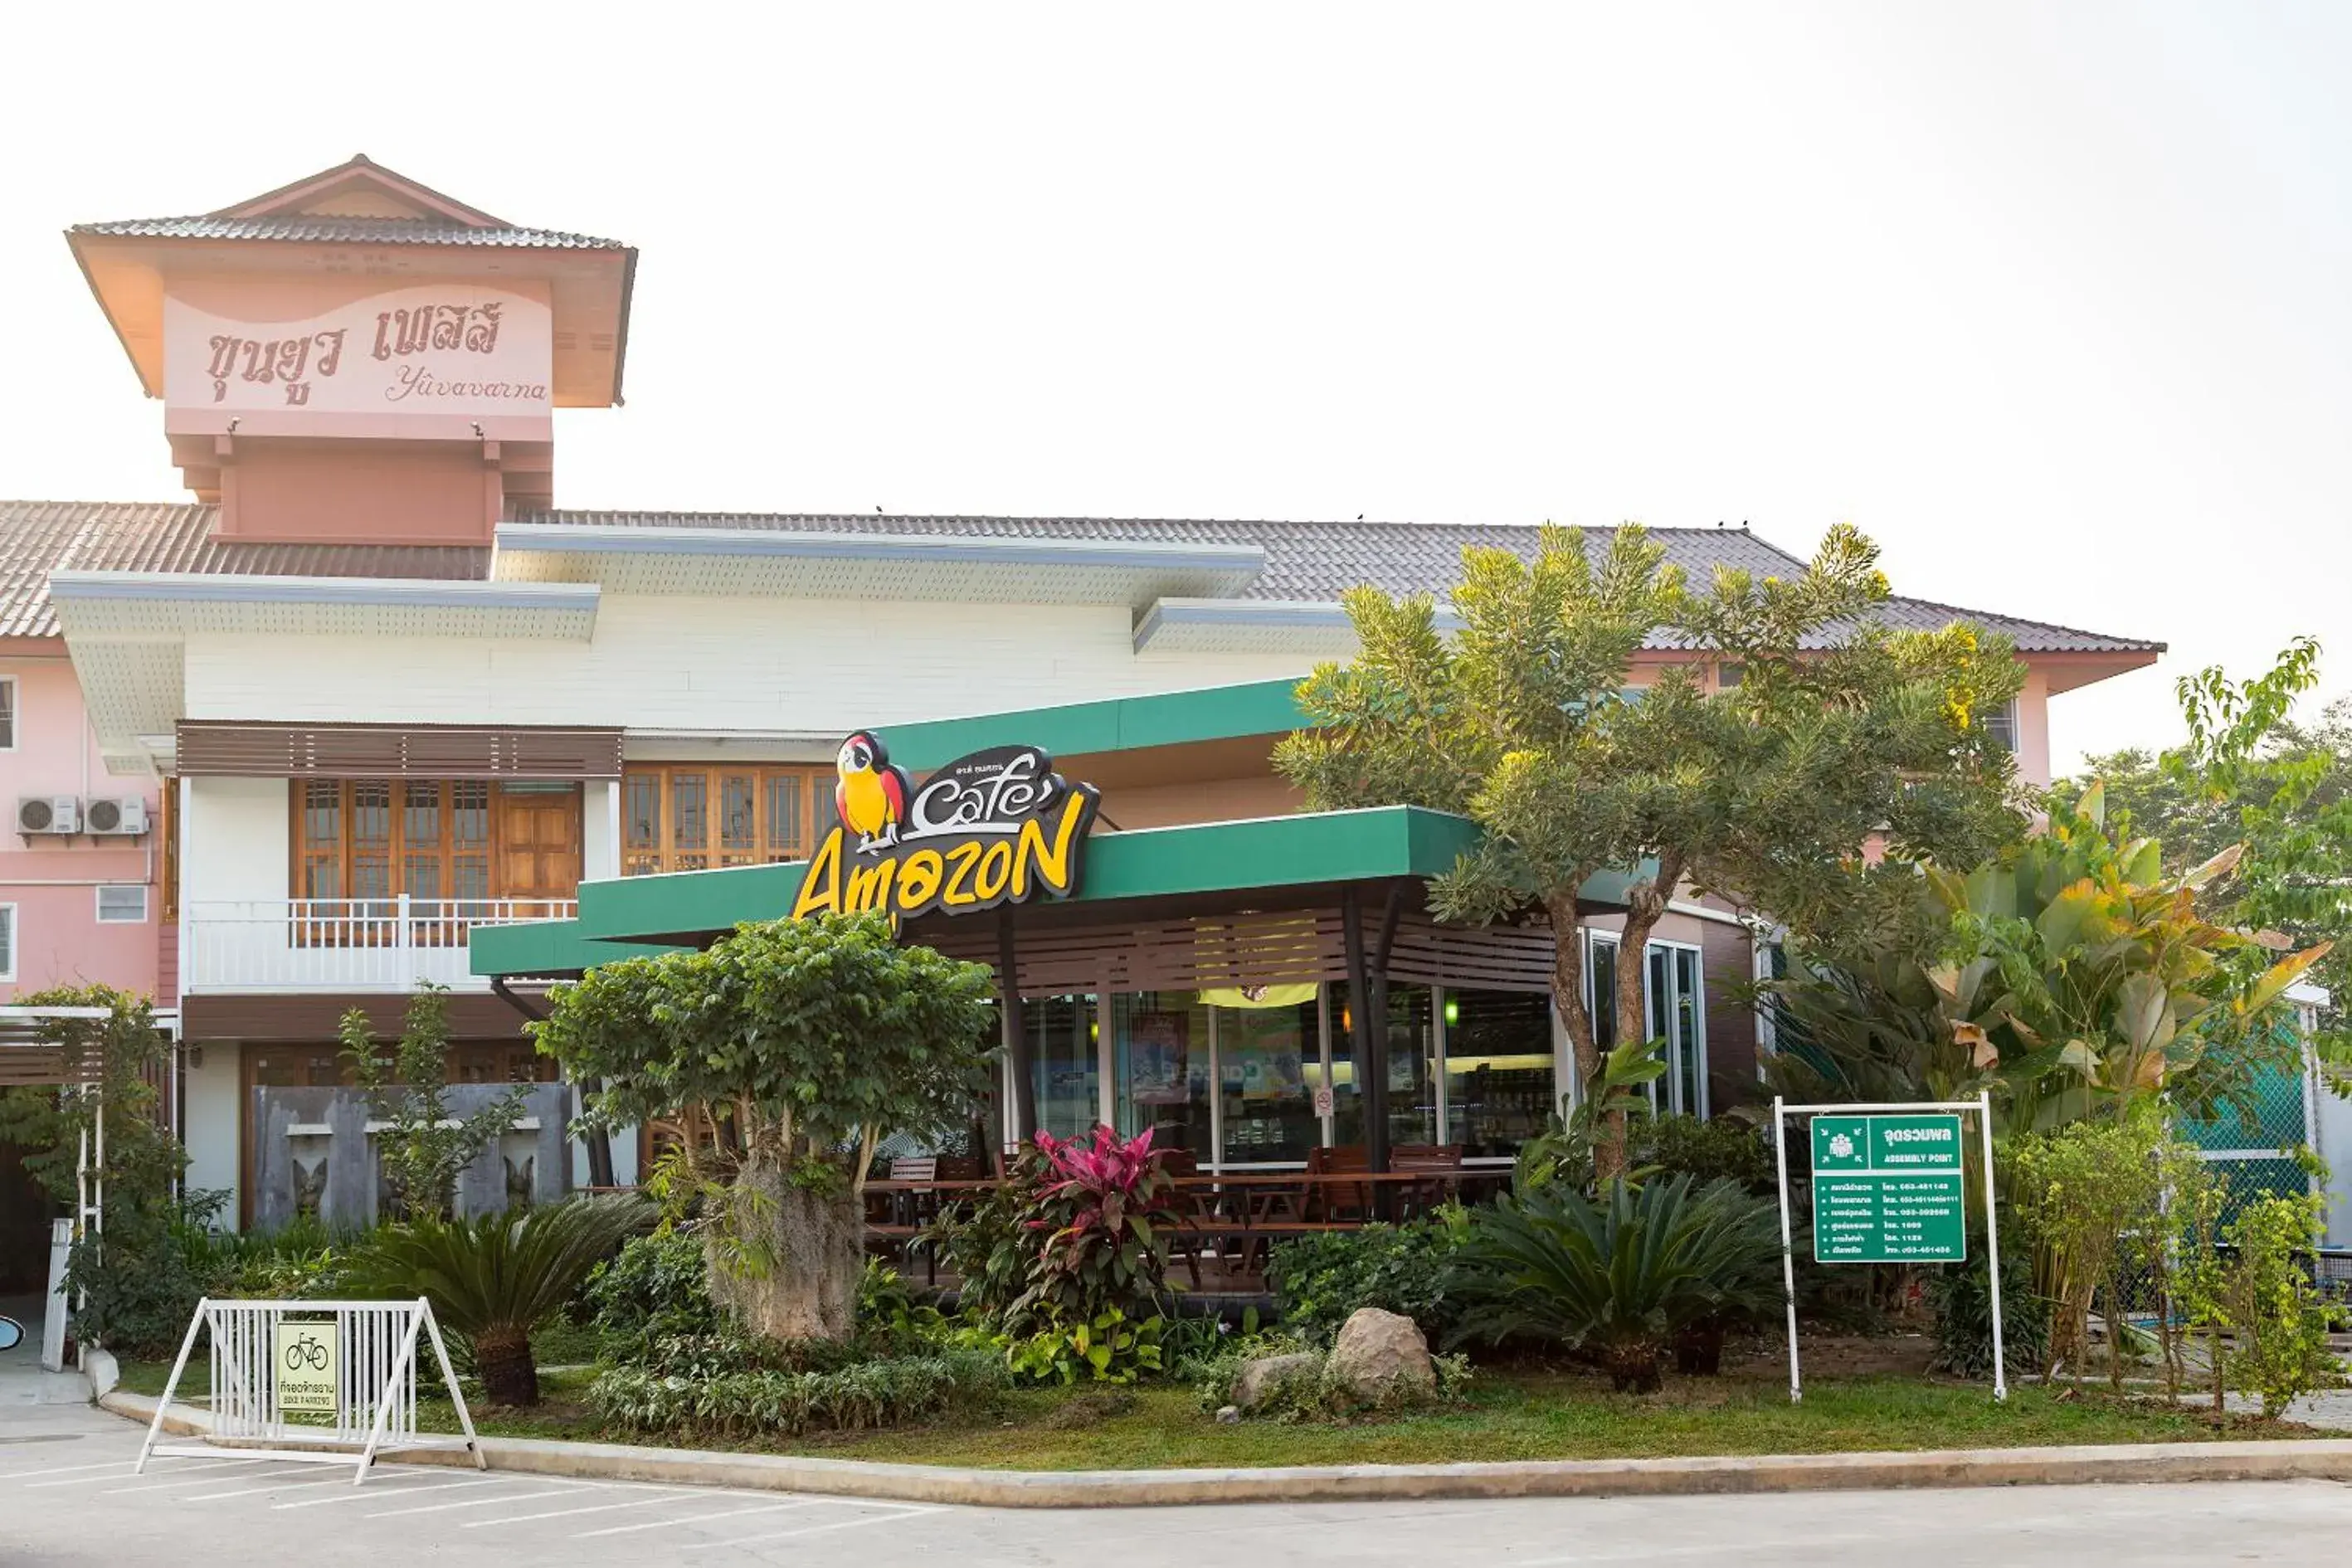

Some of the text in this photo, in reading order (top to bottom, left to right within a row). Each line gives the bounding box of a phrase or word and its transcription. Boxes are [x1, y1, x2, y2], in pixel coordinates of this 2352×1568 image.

[1884, 1128, 1951, 1147] จุดรวมพล
[1884, 1154, 1953, 1163] ASSEMBLY POINT
